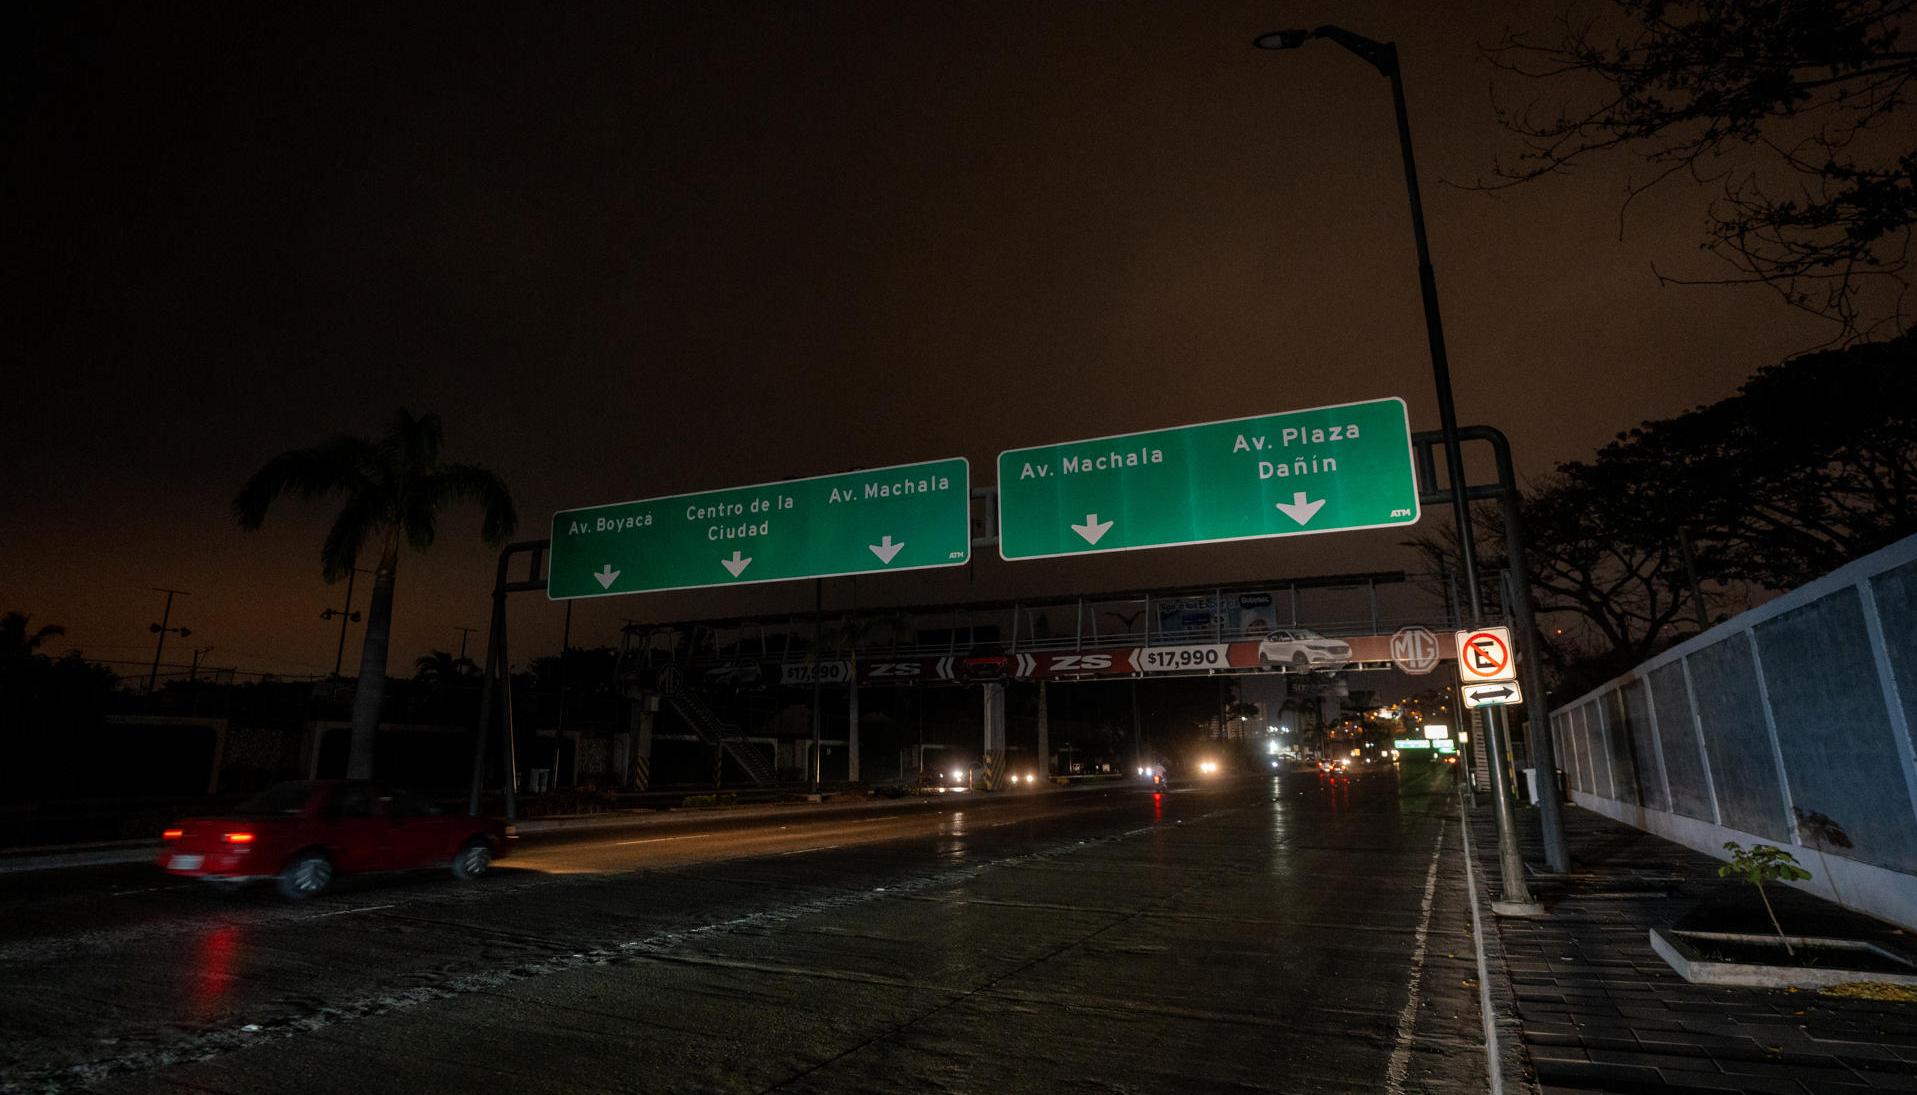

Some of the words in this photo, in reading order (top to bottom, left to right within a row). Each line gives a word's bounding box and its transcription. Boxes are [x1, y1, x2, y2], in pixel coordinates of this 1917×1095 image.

[1233, 434, 1273, 455] Av.
[1282, 422, 1361, 447] Plaza
[1020, 462, 1054, 480] Av.
[1061, 447, 1163, 475] Machala
[1258, 453, 1338, 480] Dañín
[829, 486, 857, 505] Av.
[864, 475, 950, 499] Machala
[686, 502, 743, 522] Centro
[748, 498, 769, 514] de
[777, 495, 794, 511] la
[568, 520, 591, 536] Av.
[707, 522, 769, 541] Ciudad
[1050, 654, 1113, 671] ZS
[1147, 649, 1219, 668] $17,990
[1394, 630, 1435, 668] MG
[868, 663, 923, 677] ZS
